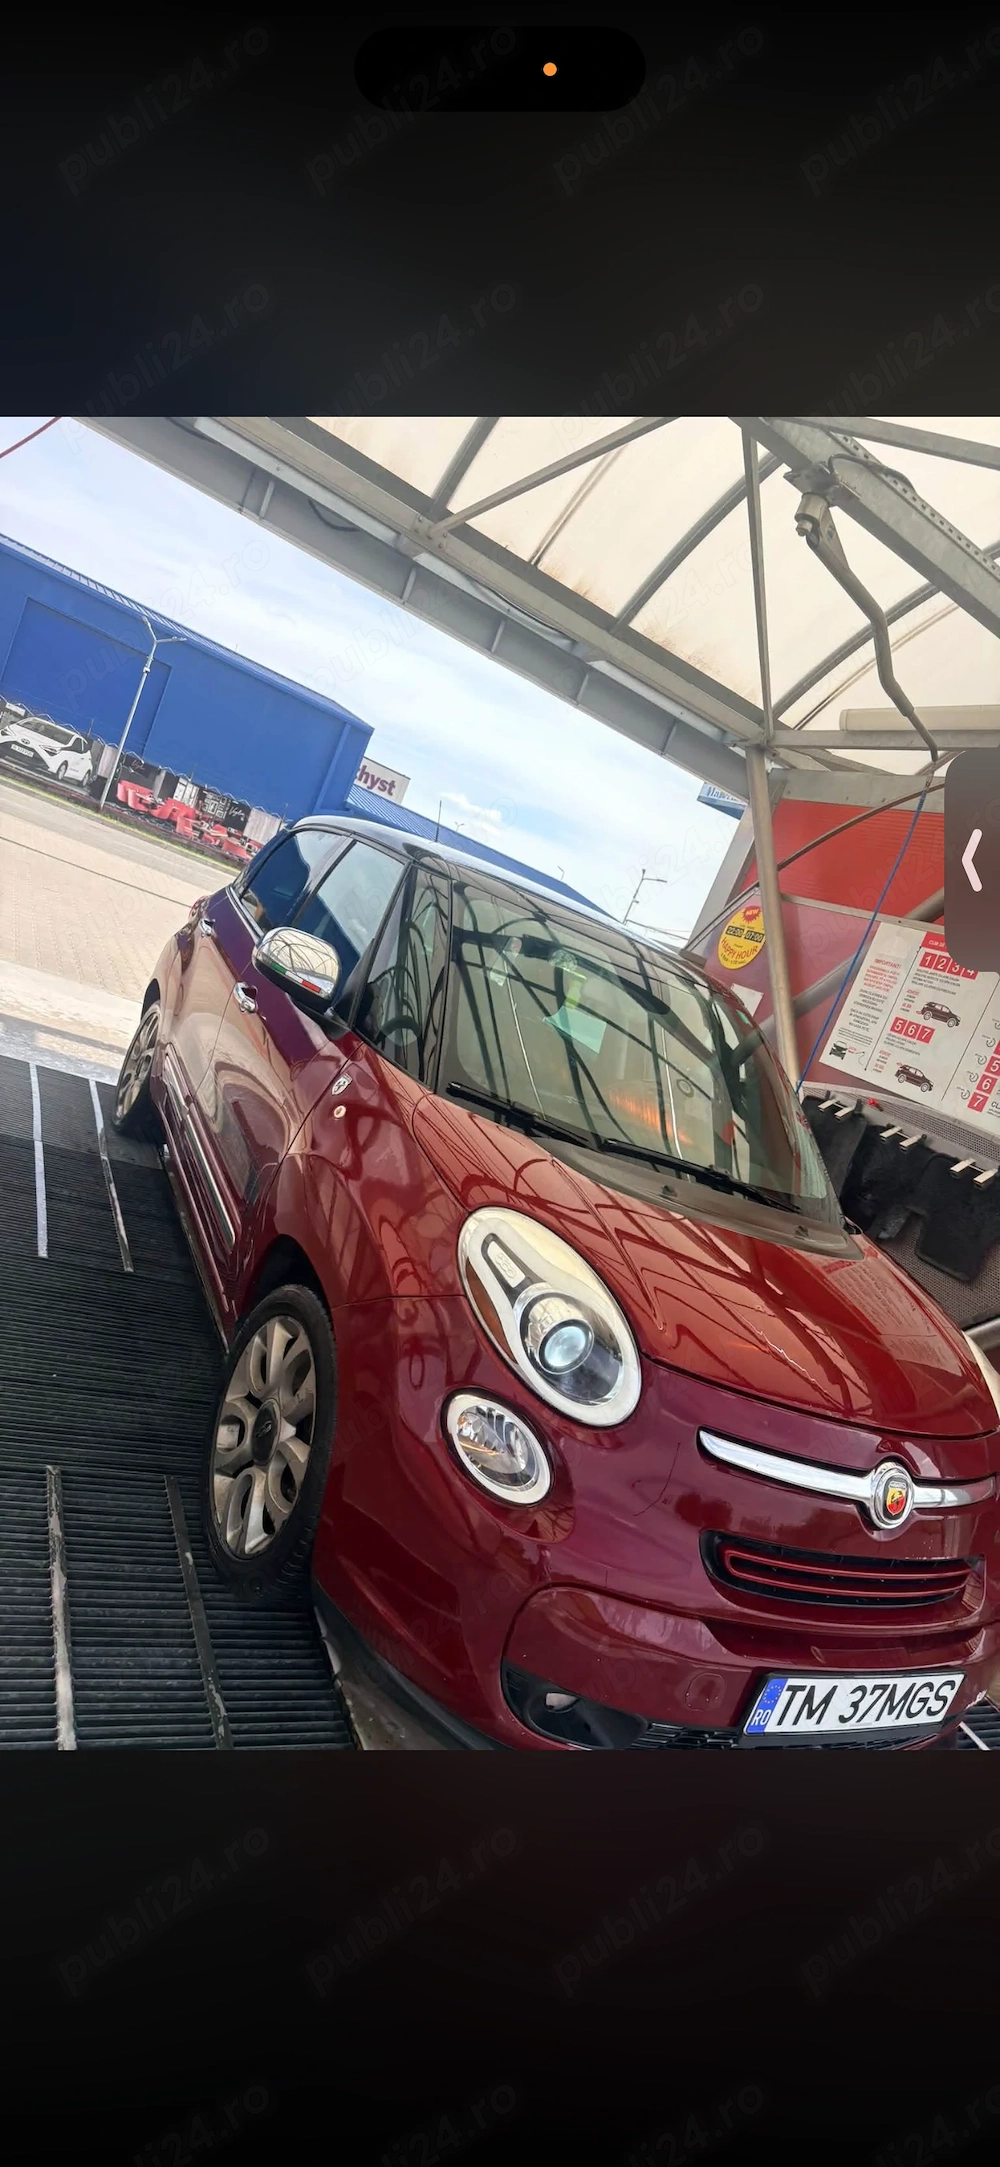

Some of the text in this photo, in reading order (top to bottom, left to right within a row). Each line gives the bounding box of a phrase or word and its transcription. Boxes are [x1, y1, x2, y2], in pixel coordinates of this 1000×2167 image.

[745, 909, 759, 917] NEW
[727, 926, 743, 936] 22:00
[746, 930, 764, 941] 07:00
[721, 937, 738, 960] HAPPY
[736, 946, 758, 960] HOUR
[925, 955, 932, 965] 1
[937, 959, 946, 969] 2
[952, 961, 960, 972] 3
[894, 1020, 930, 1040] 5 6 7
[990, 1060, 1000, 1072] 5
[982, 1078, 992, 1090] 6
[973, 1095, 985, 1107] 7
[750, 1680, 956, 1726] RO TM 37MGS
